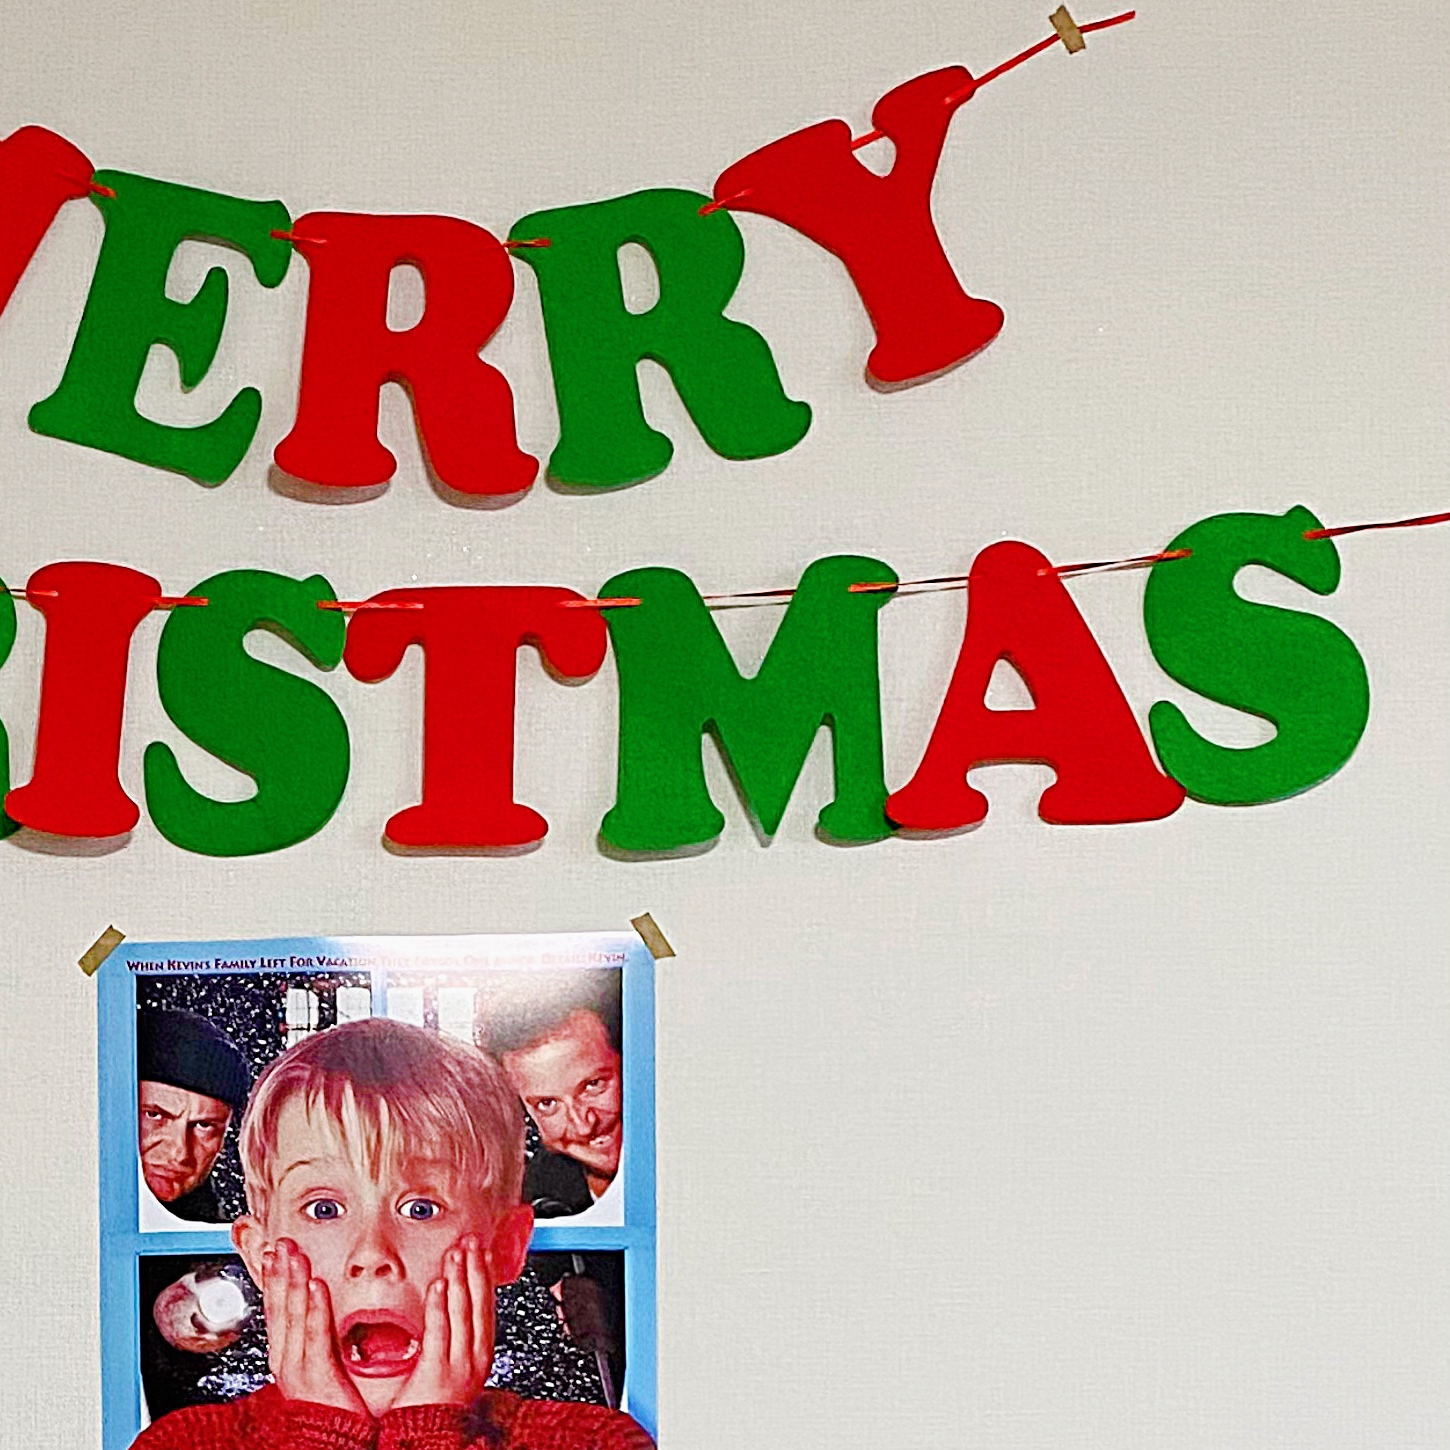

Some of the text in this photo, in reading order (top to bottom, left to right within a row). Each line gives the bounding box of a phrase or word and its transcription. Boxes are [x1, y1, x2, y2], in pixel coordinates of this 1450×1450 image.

[127, 959, 164, 972] WHEN
[214, 957, 257, 970] FAMILY
[260, 956, 286, 969] LEFT
[289, 955, 314, 968] FOR
